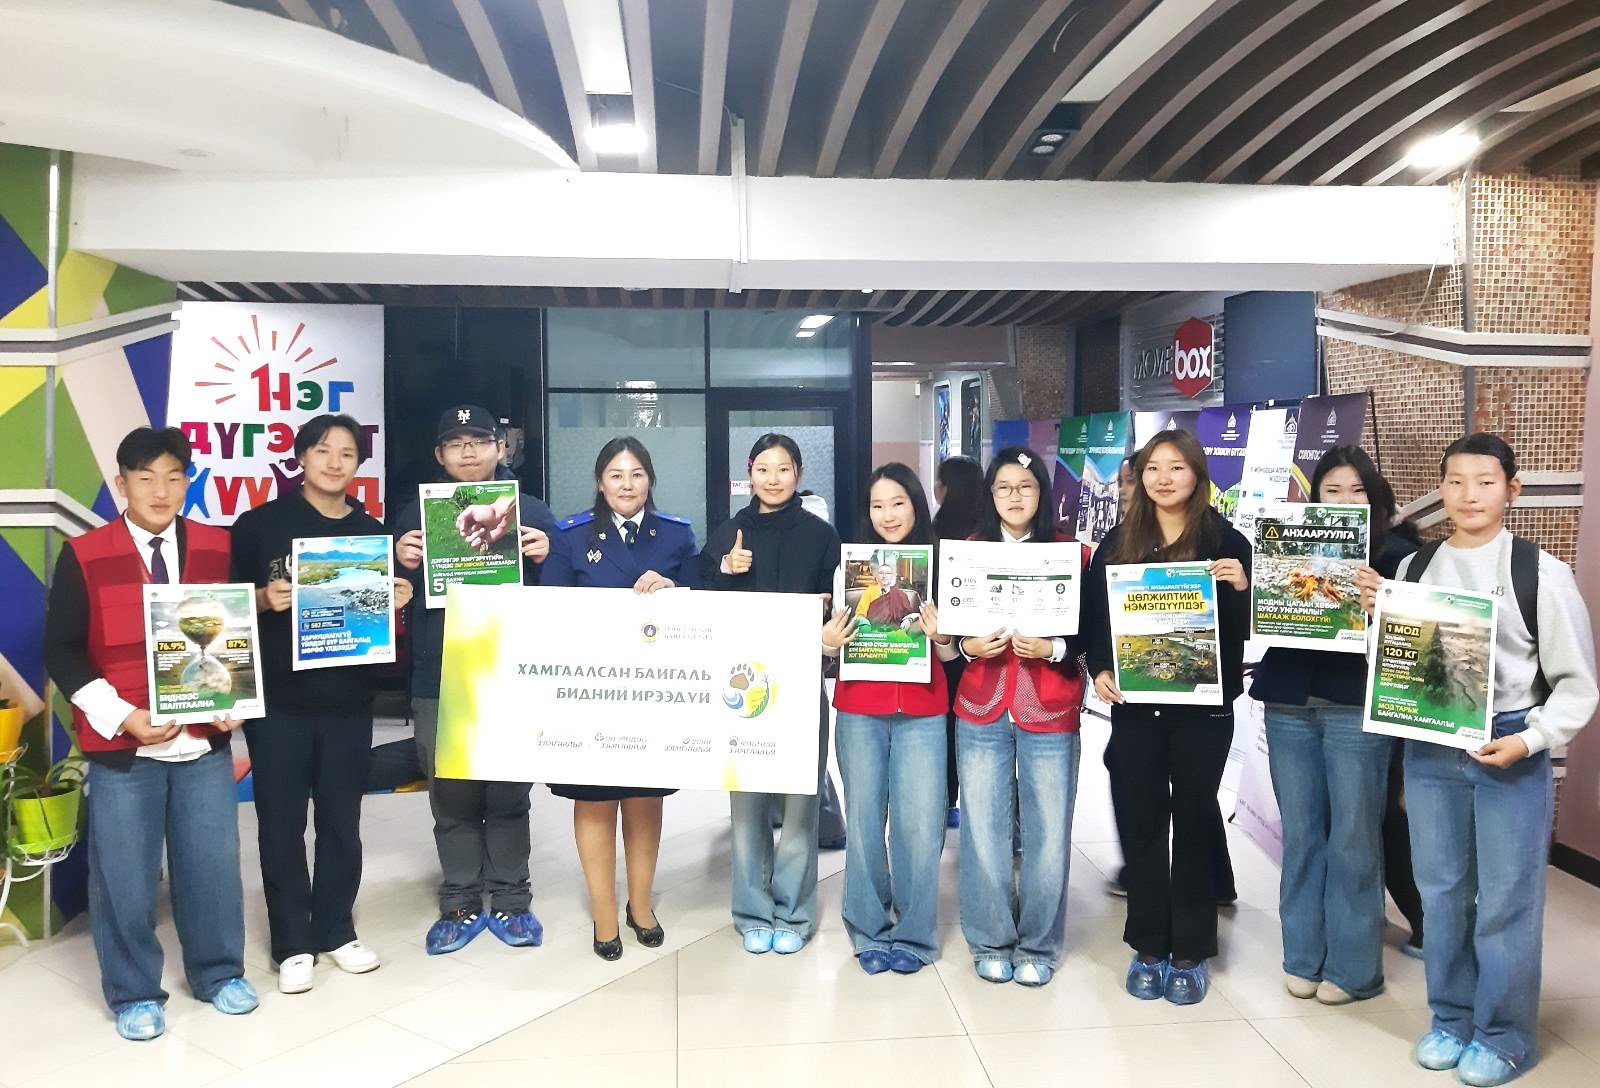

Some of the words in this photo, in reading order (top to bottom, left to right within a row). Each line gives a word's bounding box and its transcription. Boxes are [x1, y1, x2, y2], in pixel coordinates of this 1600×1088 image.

[1175, 340, 1211, 380] box
[1282, 527, 1355, 540] АНХААРУУЛГА
[434, 578, 445, 592] 5
[1128, 592, 1200, 602] ЦӨЛЖИЛТИЙГ
[1124, 602, 1206, 611] НЭМЭГДҮҮЛДЭГ
[1258, 598, 1284, 606] МОДНЫ
[1286, 600, 1314, 608] ЦАГААН
[1257, 612, 1290, 620] ШАТААЖ
[1280, 607, 1324, 615] УНГАРИЛЫГ
[1388, 624, 1392, 632] 1
[1394, 625, 1420, 637] МОД
[158, 642, 185, 650] 76.9%
[228, 640, 247, 648] 87%
[1385, 647, 1403, 657] 120
[1405, 650, 1418, 659] КГ
[518, 663, 631, 679] ХАМГААЛСАН
[634, 665, 712, 681] БАЙГАЛЬ
[556, 685, 628, 701] БИДНИЙ
[632, 688, 711, 704] ИРЭЭДҮЙ
[1378, 702, 1394, 711] МОД
